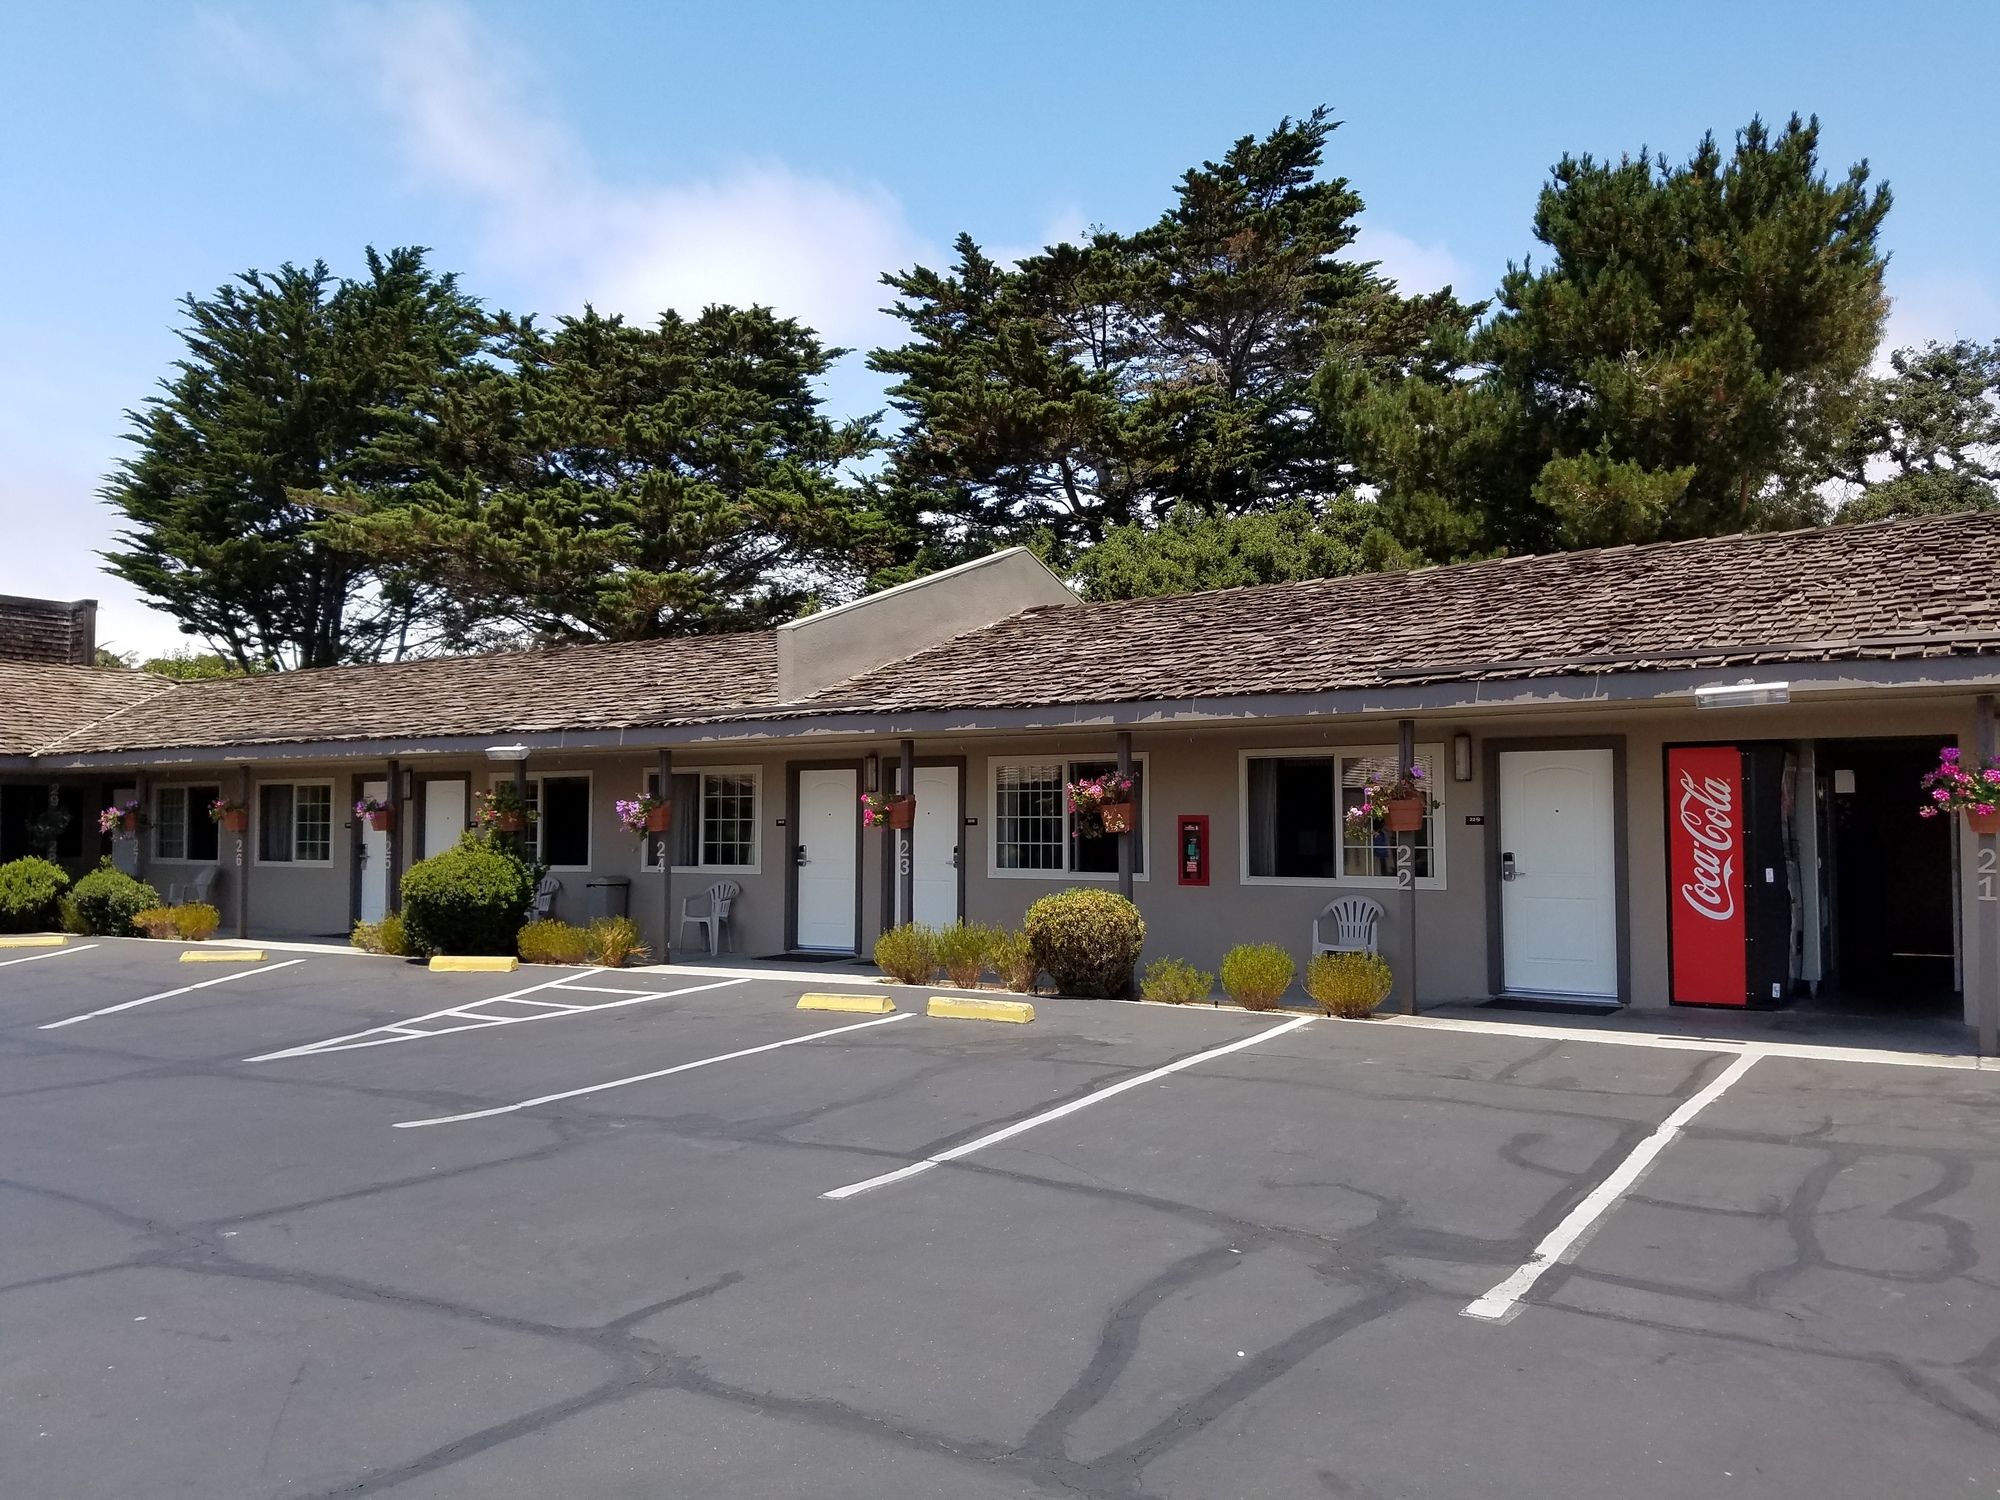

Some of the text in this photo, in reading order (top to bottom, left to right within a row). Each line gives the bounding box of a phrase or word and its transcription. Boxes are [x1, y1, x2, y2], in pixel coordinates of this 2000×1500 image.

[236, 839, 242, 866] 26
[656, 841, 666, 873] 24
[899, 839, 910, 875] 23
[1680, 768, 1734, 921] Coca-Cola
[1397, 844, 1411, 890] 22
[1977, 847, 1998, 901] 21
